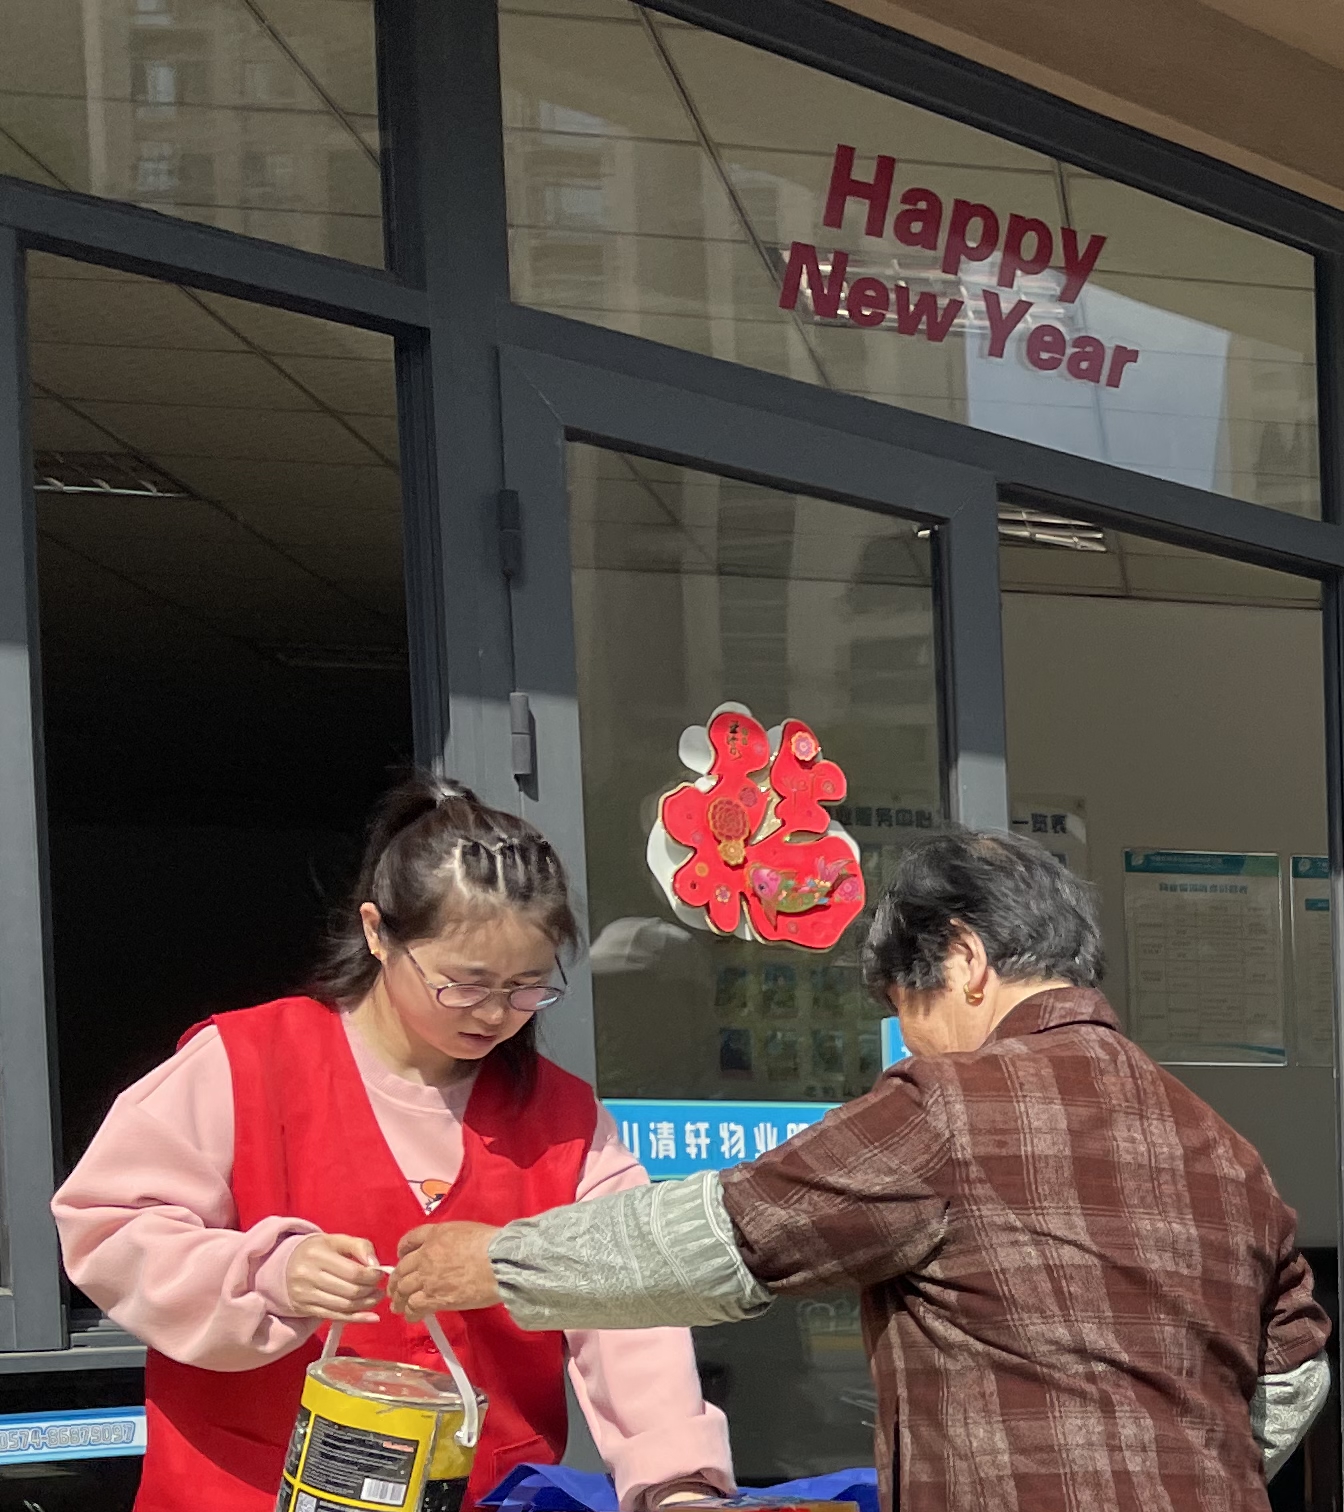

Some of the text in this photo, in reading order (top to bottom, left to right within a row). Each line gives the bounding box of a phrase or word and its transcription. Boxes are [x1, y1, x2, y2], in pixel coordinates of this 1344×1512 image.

[823, 143, 1108, 304] Happy
[779, 241, 1140, 388] New Year
